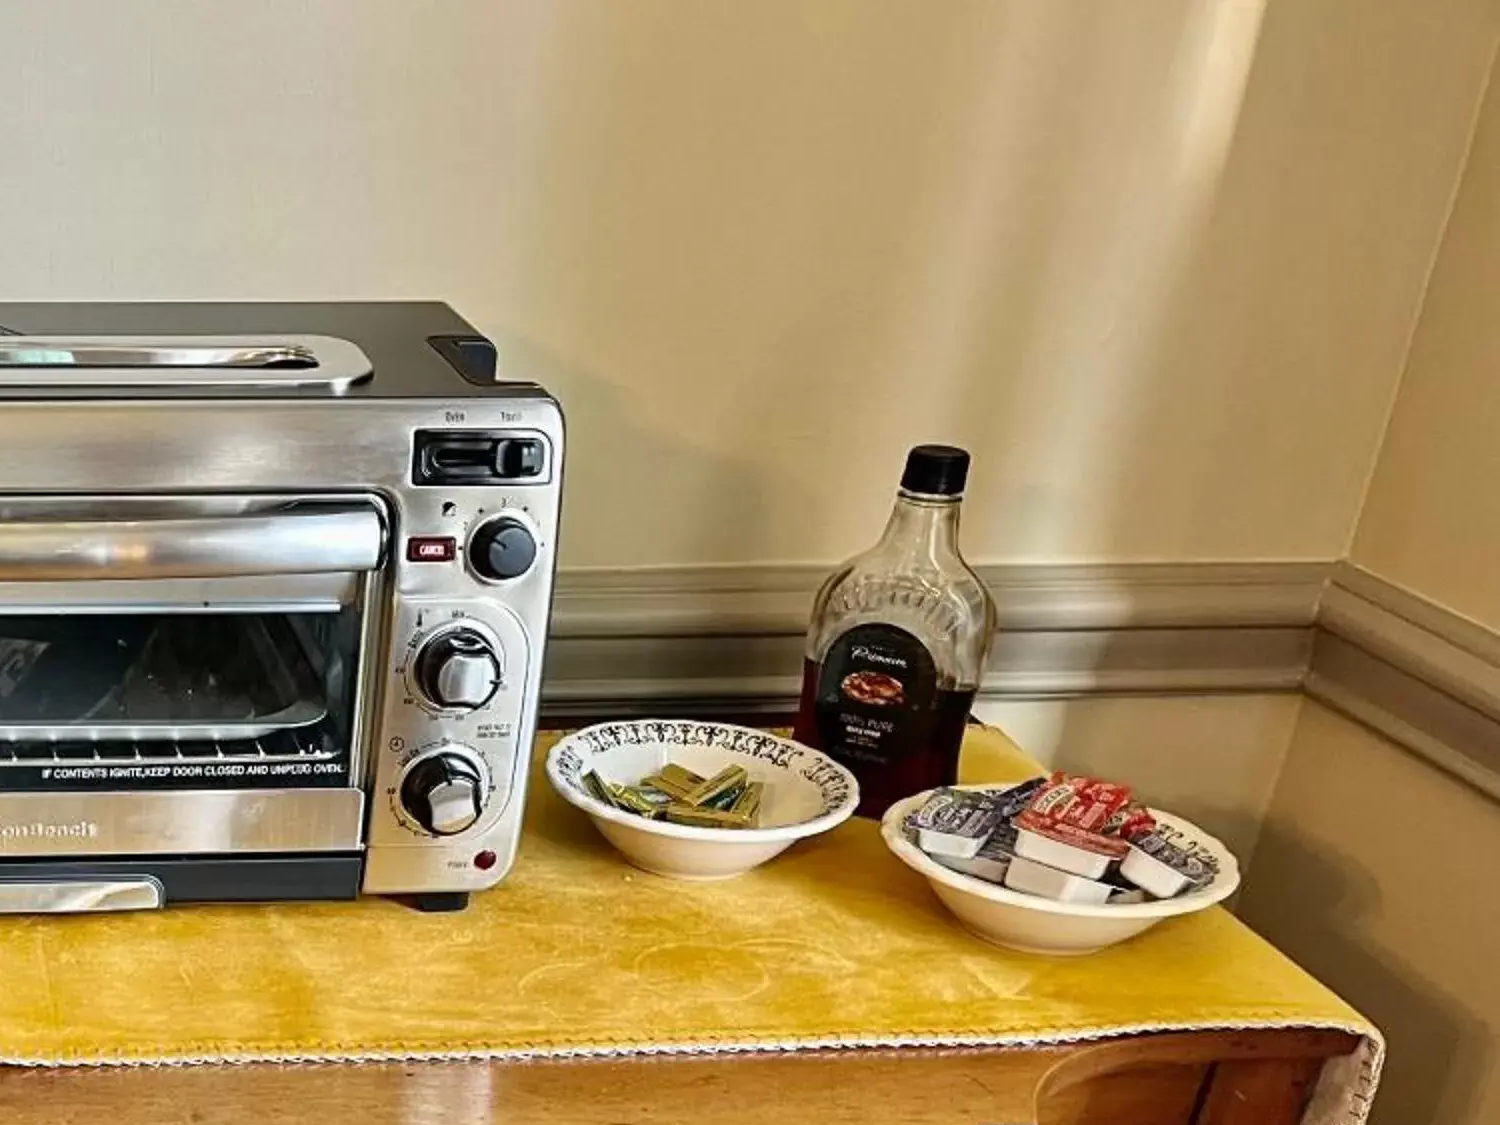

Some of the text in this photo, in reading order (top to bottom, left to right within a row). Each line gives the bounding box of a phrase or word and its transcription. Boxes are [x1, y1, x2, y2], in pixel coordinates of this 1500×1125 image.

[41, 769, 52, 779] IF
[53, 768, 108, 779] CONTENTS
[173, 766, 203, 777] DOOR
[203, 765, 245, 776] CLOSED
[246, 764, 269, 775] AND
[270, 763, 312, 774] UNPLUG
